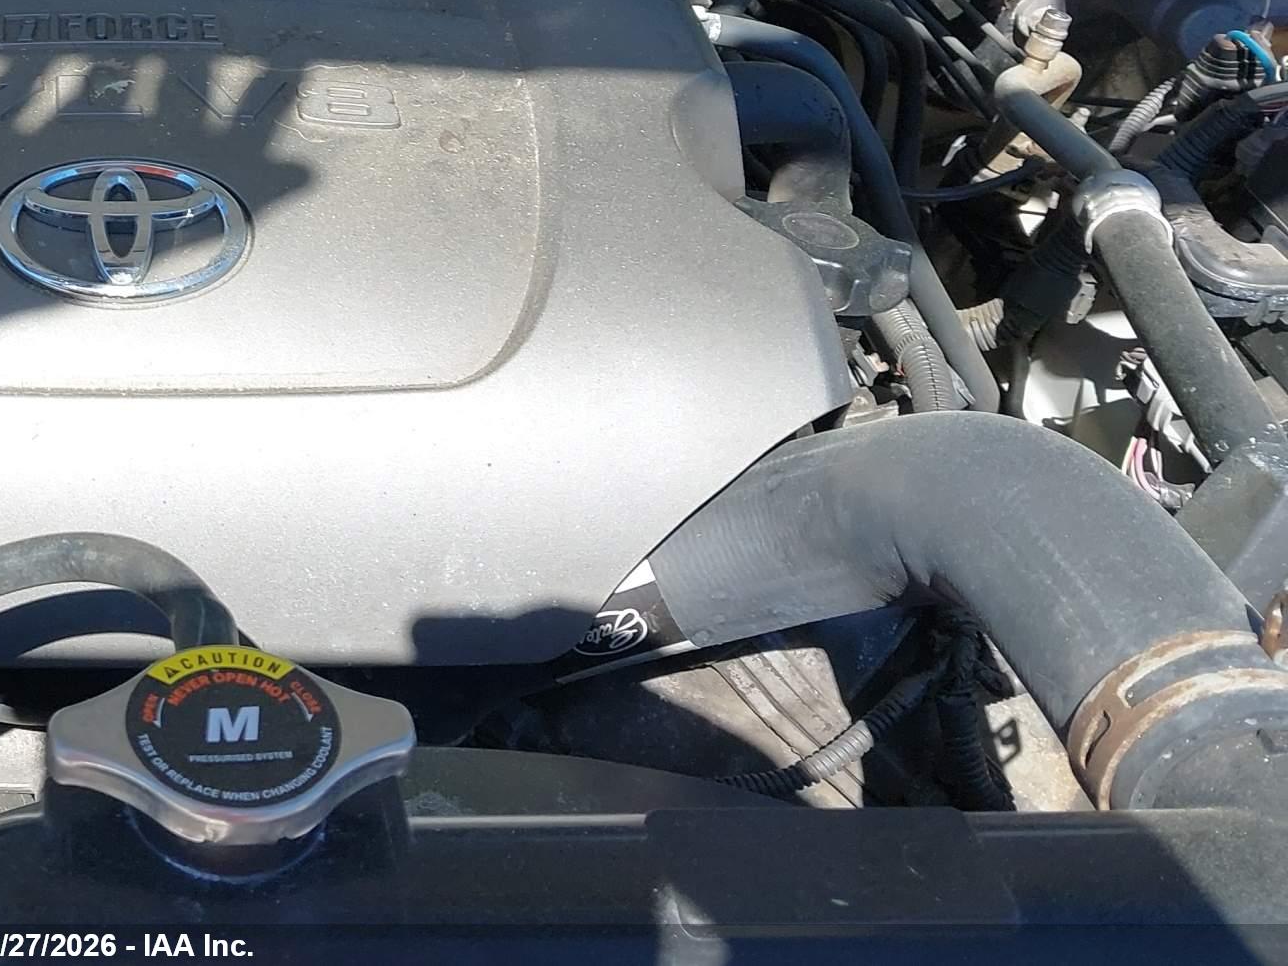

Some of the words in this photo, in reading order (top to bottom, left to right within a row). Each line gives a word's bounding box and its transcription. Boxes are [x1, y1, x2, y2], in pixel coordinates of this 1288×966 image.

[179, 652, 281, 674] CAUTION
[167, 675, 211, 707] NEVER
[213, 671, 258, 687] OPEN
[259, 680, 291, 703] HOT
[205, 706, 260, 743] M
[137, 733, 158, 757] TEST
[152, 756, 169, 773] OR
[166, 769, 220, 798] REPLACE
[222, 791, 261, 801] WHEN
[262, 767, 317, 799] CHANGING
[313, 726, 333, 769] COOLANT
